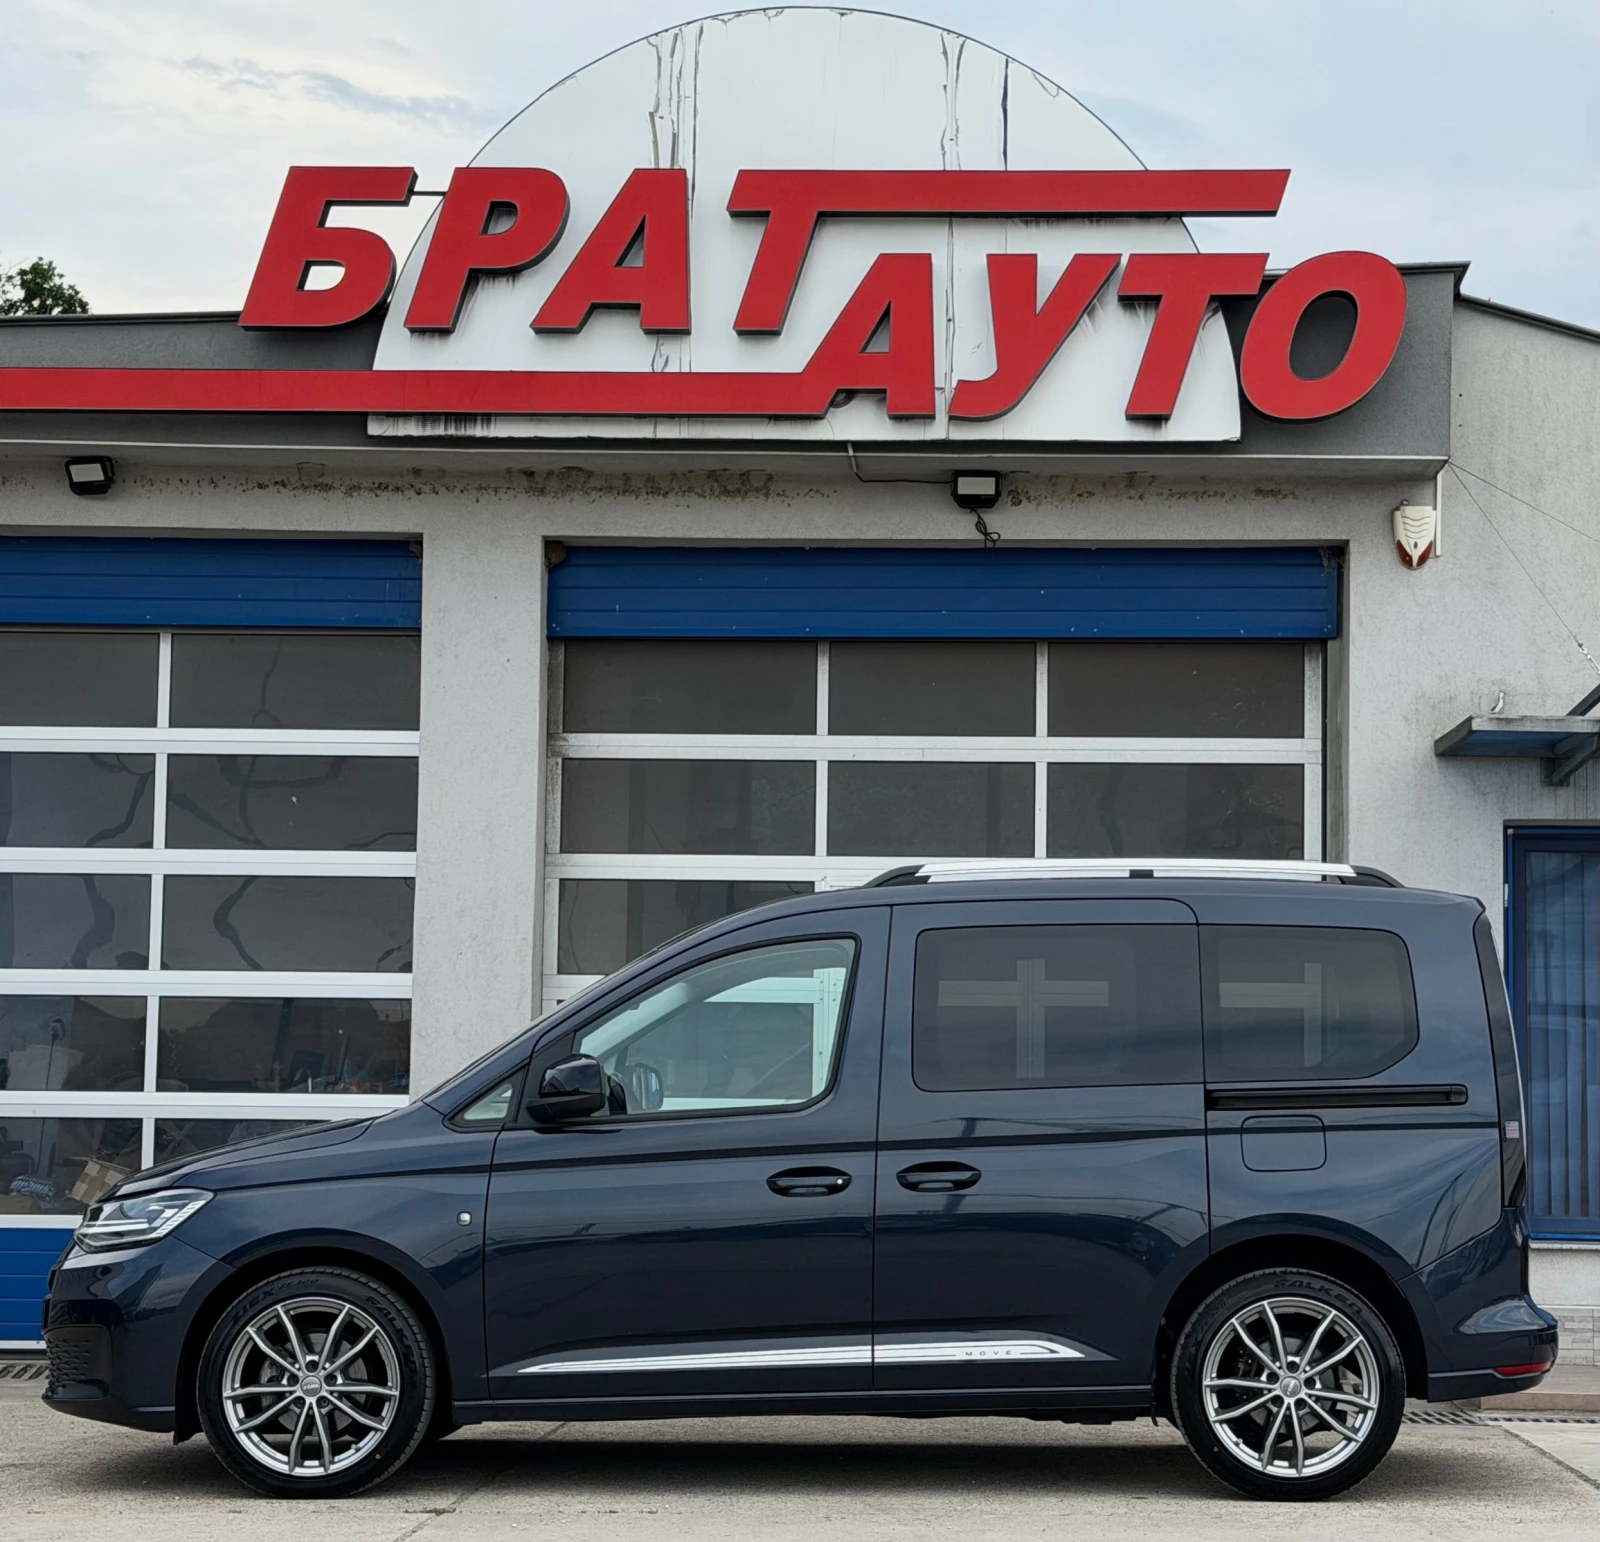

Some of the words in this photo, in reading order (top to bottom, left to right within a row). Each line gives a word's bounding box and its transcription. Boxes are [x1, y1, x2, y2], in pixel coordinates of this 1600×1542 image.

[240, 166, 1291, 335] БРАТ
[800, 250, 1408, 421] АУТО
[1273, 1279, 1364, 1314] FALKEN
